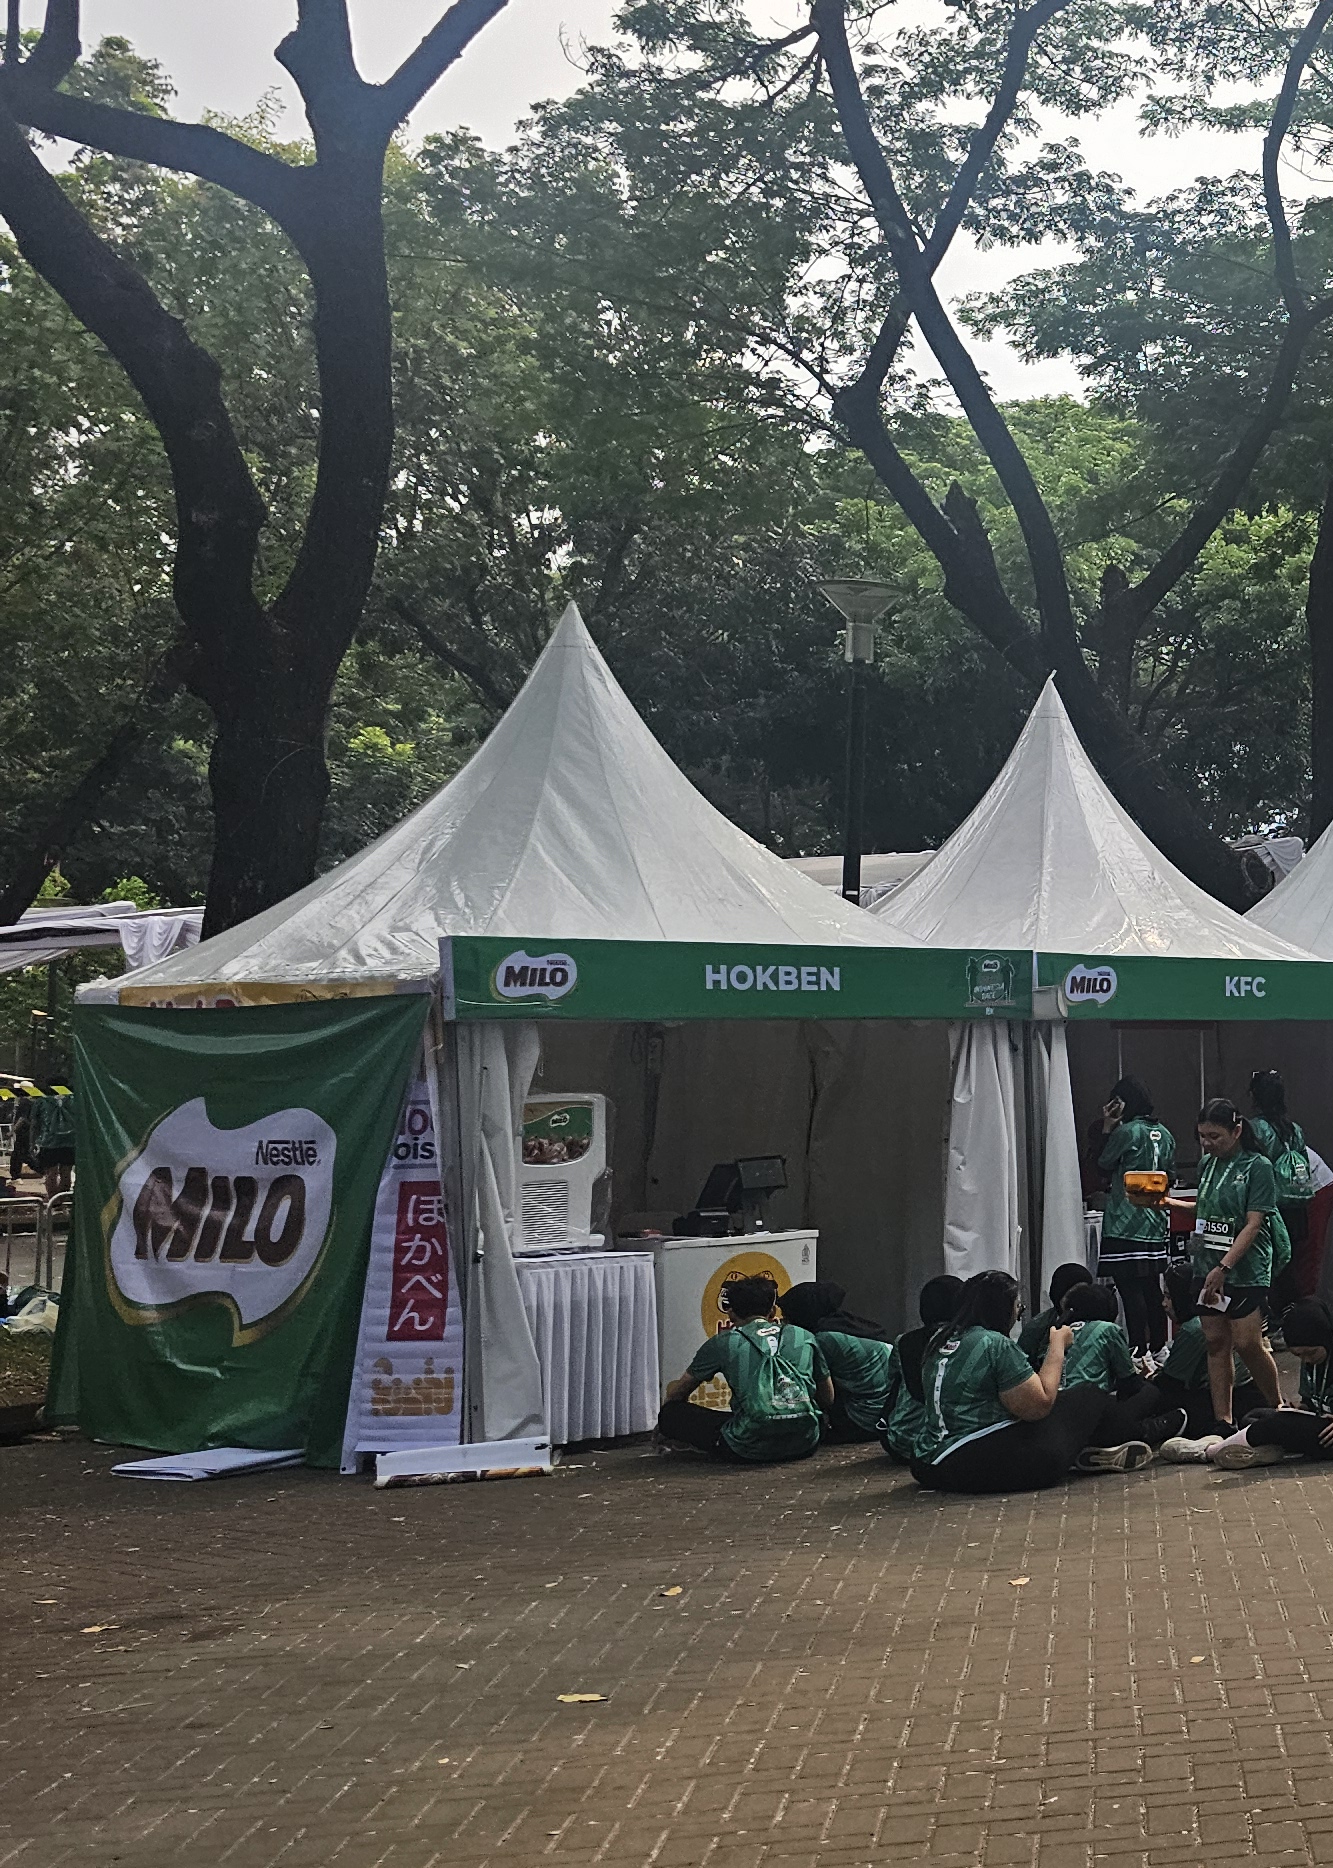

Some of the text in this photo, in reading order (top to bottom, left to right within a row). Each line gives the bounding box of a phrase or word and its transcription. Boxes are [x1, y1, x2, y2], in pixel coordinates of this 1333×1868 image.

[504, 966, 569, 988] MILO
[705, 964, 841, 991] HOKBEN
[1070, 976, 1112, 994] MILO
[1225, 976, 1266, 998] KFC
[133, 1167, 306, 1267] MILO
[393, 1195, 445, 1332] ほかべん
